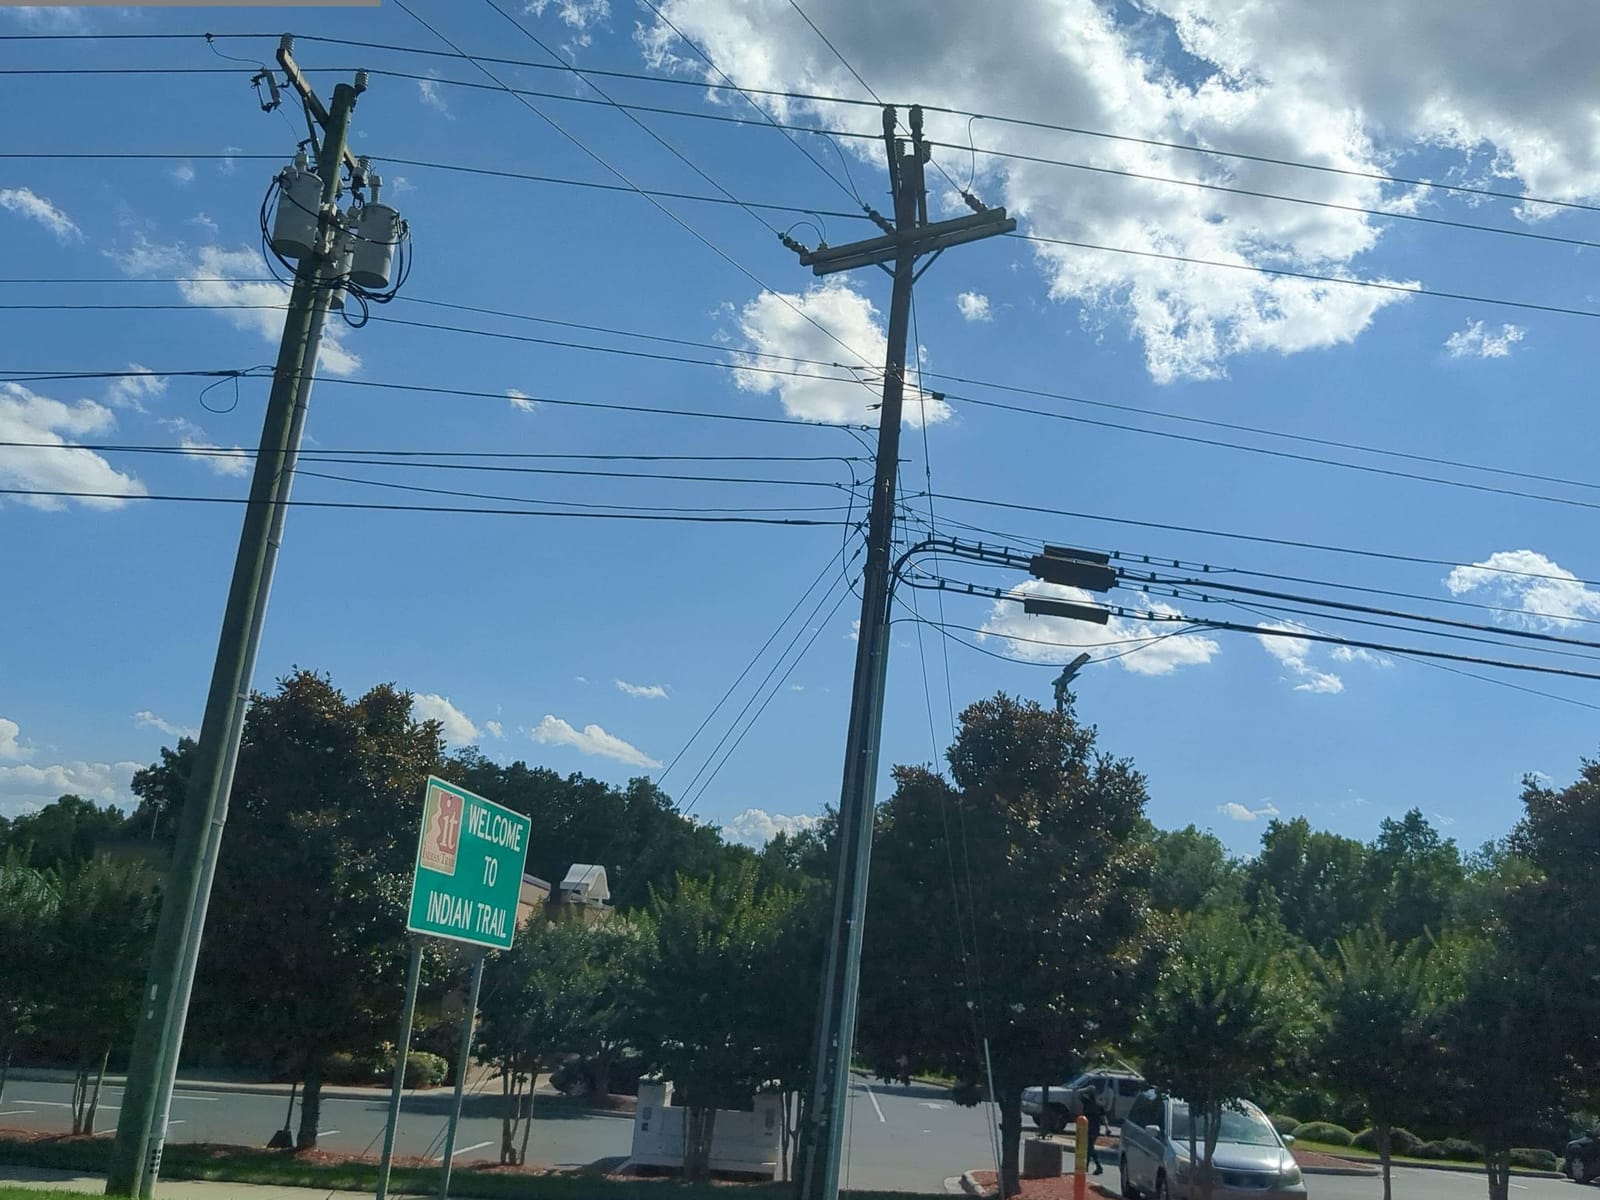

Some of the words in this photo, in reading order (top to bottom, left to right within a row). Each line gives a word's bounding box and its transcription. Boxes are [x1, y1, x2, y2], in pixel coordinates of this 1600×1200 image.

[468, 804, 523, 852] WELCOME
[483, 856, 498, 887] TO
[426, 890, 473, 930] INDIAN
[475, 902, 507, 938] TRAIL
